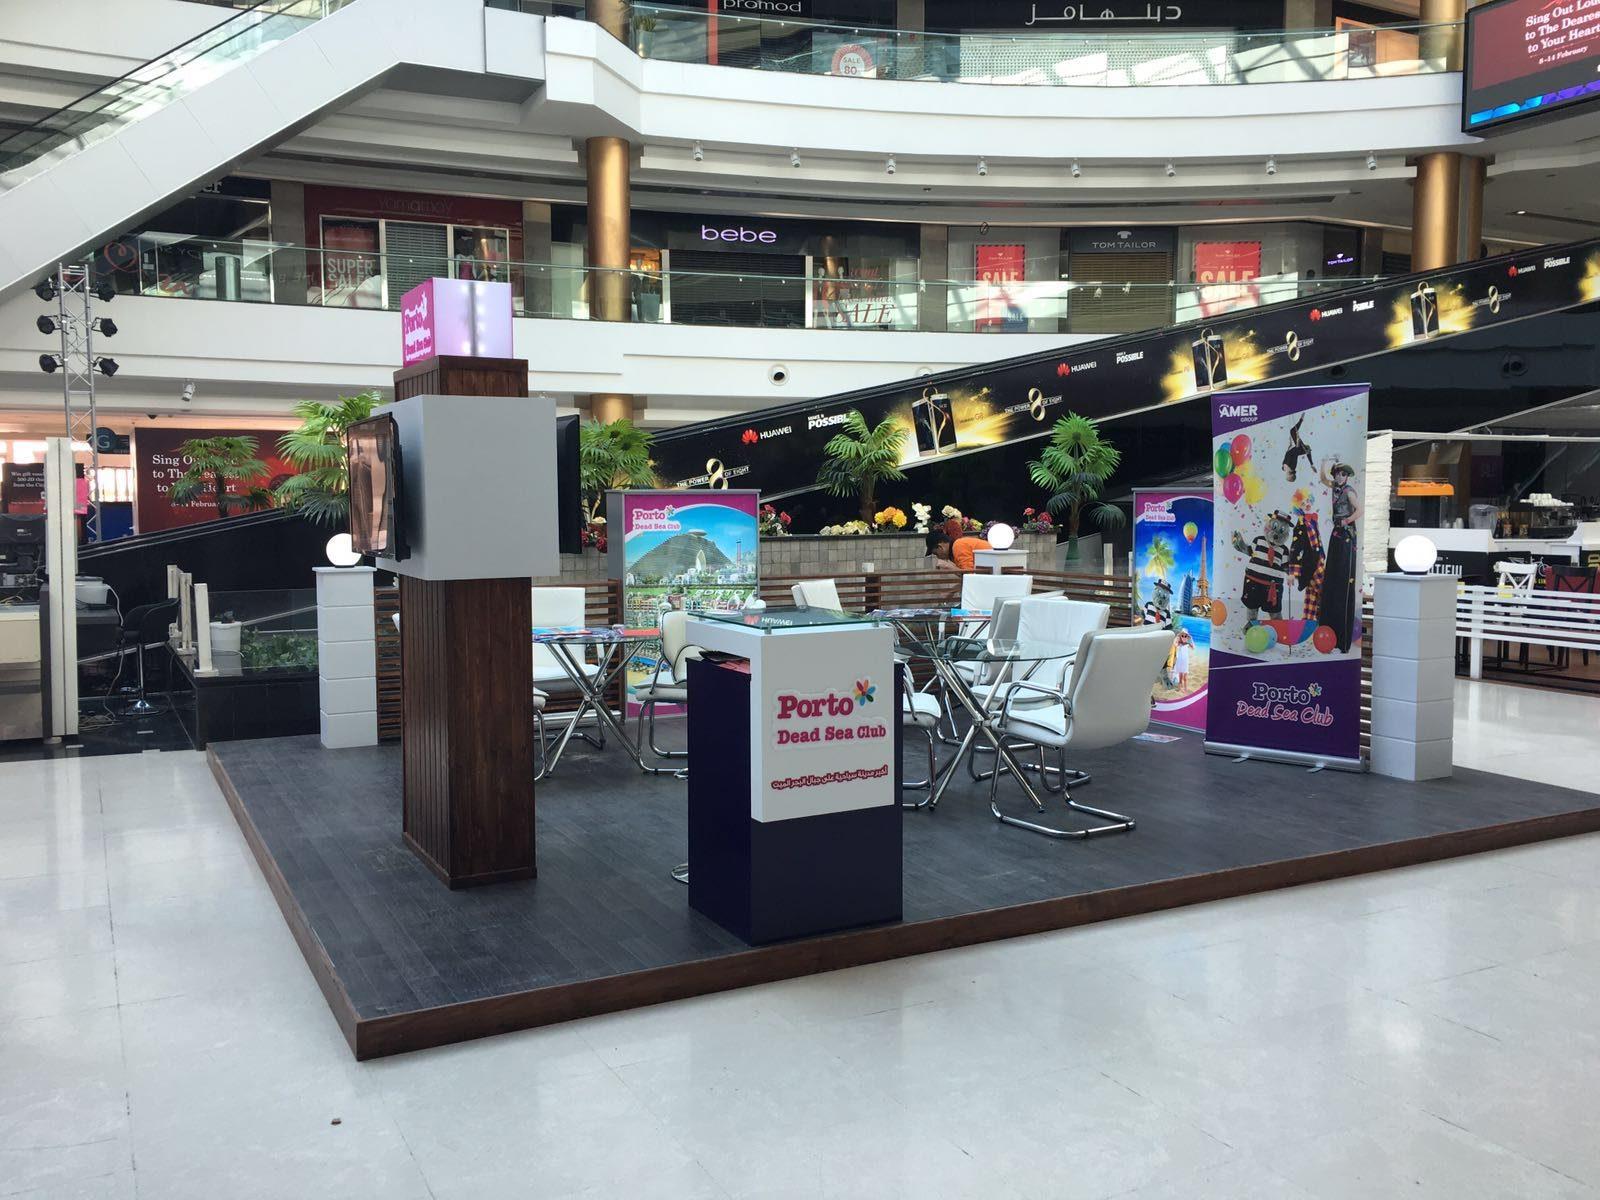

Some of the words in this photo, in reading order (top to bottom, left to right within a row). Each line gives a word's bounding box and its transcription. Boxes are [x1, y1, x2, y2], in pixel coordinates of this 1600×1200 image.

[723, 0, 801, 12] promod
[1525, 13, 1551, 27] Sing
[1552, 6, 1574, 18] Out
[1524, 31, 1536, 40] to
[1538, 24, 1560, 37] The
[1527, 44, 1539, 54] to
[1541, 36, 1567, 49] Your
[1557, 46, 1588, 59] February
[701, 225, 777, 243] bebe
[1092, 241, 1116, 249] TOM
[1119, 241, 1157, 249] TAILOR
[327, 258, 374, 274] SUPER
[1116, 352, 1144, 364] POSSIBLE
[1071, 361, 1097, 373] HUAWEI
[1219, 404, 1258, 417] AMER
[759, 426, 793, 439] HUAWEI
[152, 455, 180, 466] Sing
[152, 469, 165, 479] to
[156, 483, 169, 492] to
[688, 476, 710, 487] POWER
[634, 510, 666, 520] Porto
[1252, 682, 1311, 705] Porto
[777, 693, 854, 719] Porto
[1236, 700, 1271, 719] Dead
[1271, 704, 1299, 721] Sea
[1301, 704, 1334, 726] Club
[777, 728, 821, 744] Dead
[825, 726, 854, 741] Sea
[857, 724, 886, 738] Club
